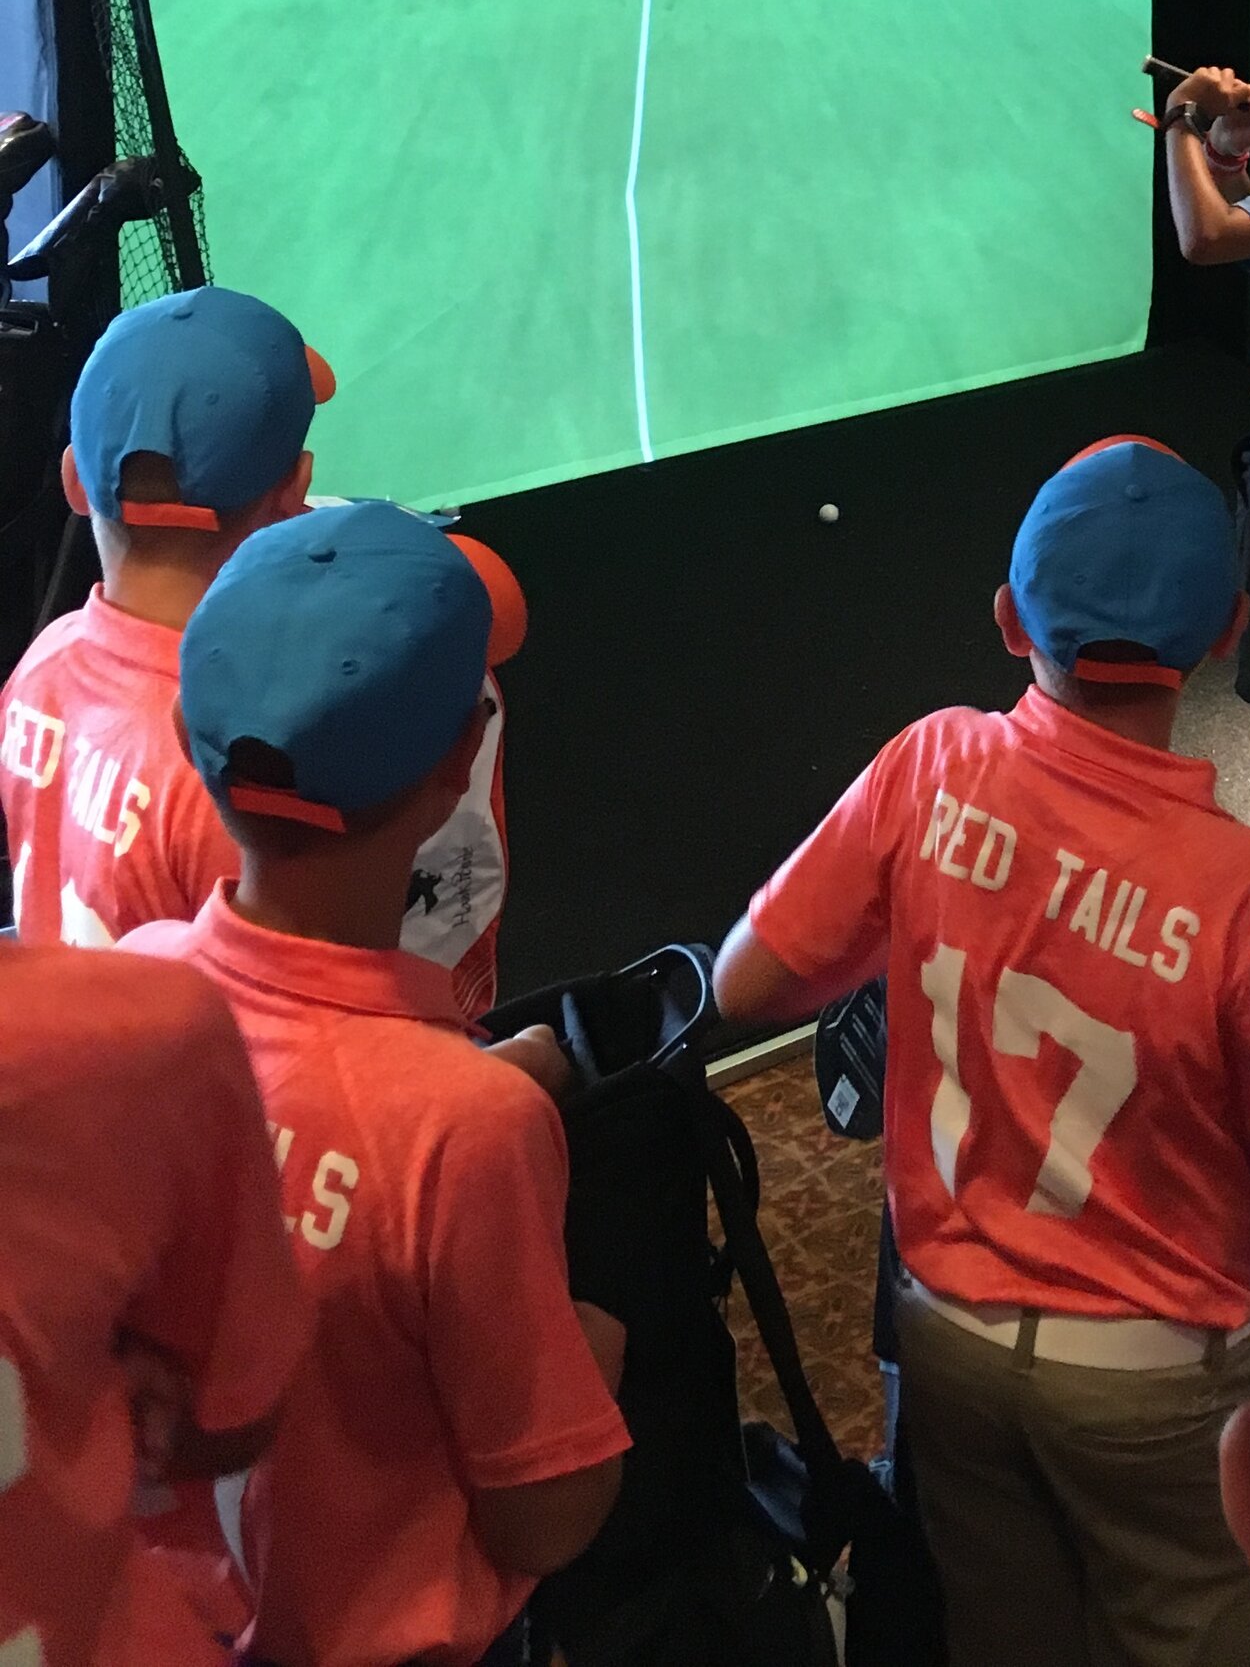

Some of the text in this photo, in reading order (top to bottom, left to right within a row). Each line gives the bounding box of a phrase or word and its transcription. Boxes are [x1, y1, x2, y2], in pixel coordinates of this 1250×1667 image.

[1, 698, 151, 858] RED TAILS
[919, 788, 1200, 983] RED TAILS
[920, 942, 1138, 1219] 17
